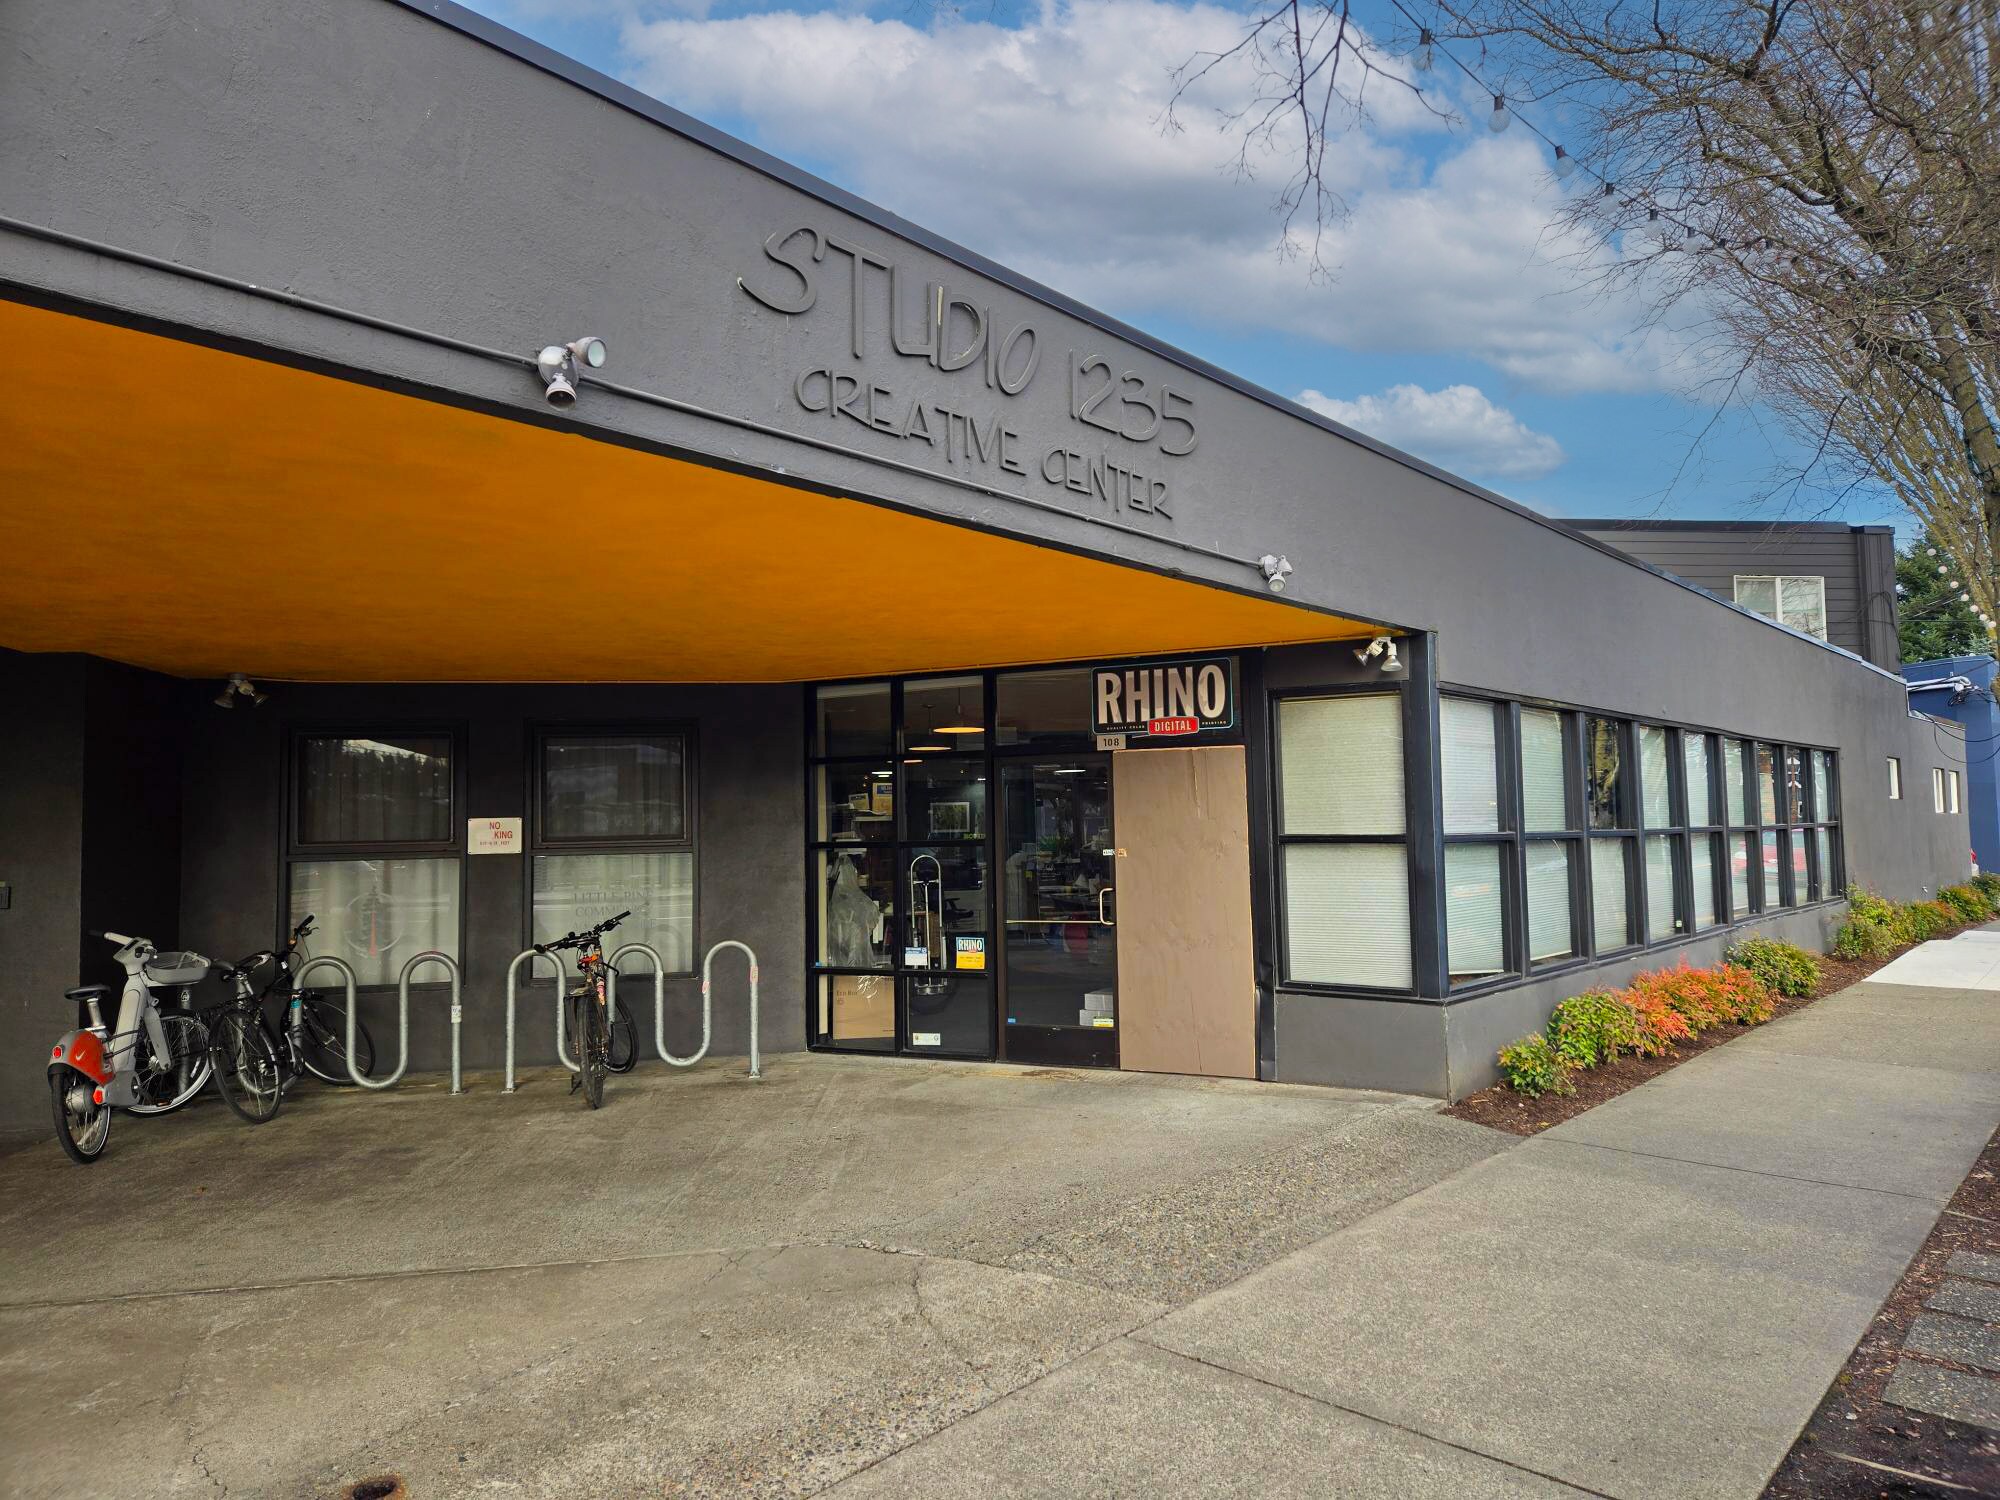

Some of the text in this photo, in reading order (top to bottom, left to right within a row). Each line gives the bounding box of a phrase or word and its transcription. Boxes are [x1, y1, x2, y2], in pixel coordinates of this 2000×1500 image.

[737, 226, 1199, 456] STUDIO 1235
[794, 367, 1173, 519] CREATIVE CENTER
[1097, 664, 1226, 725] RHINO
[1154, 719, 1192, 732] DIGITAL
[1103, 734, 1120, 747] 108
[489, 821, 501, 830] NO
[494, 830, 513, 839] KING
[958, 939, 983, 951] RHINO
